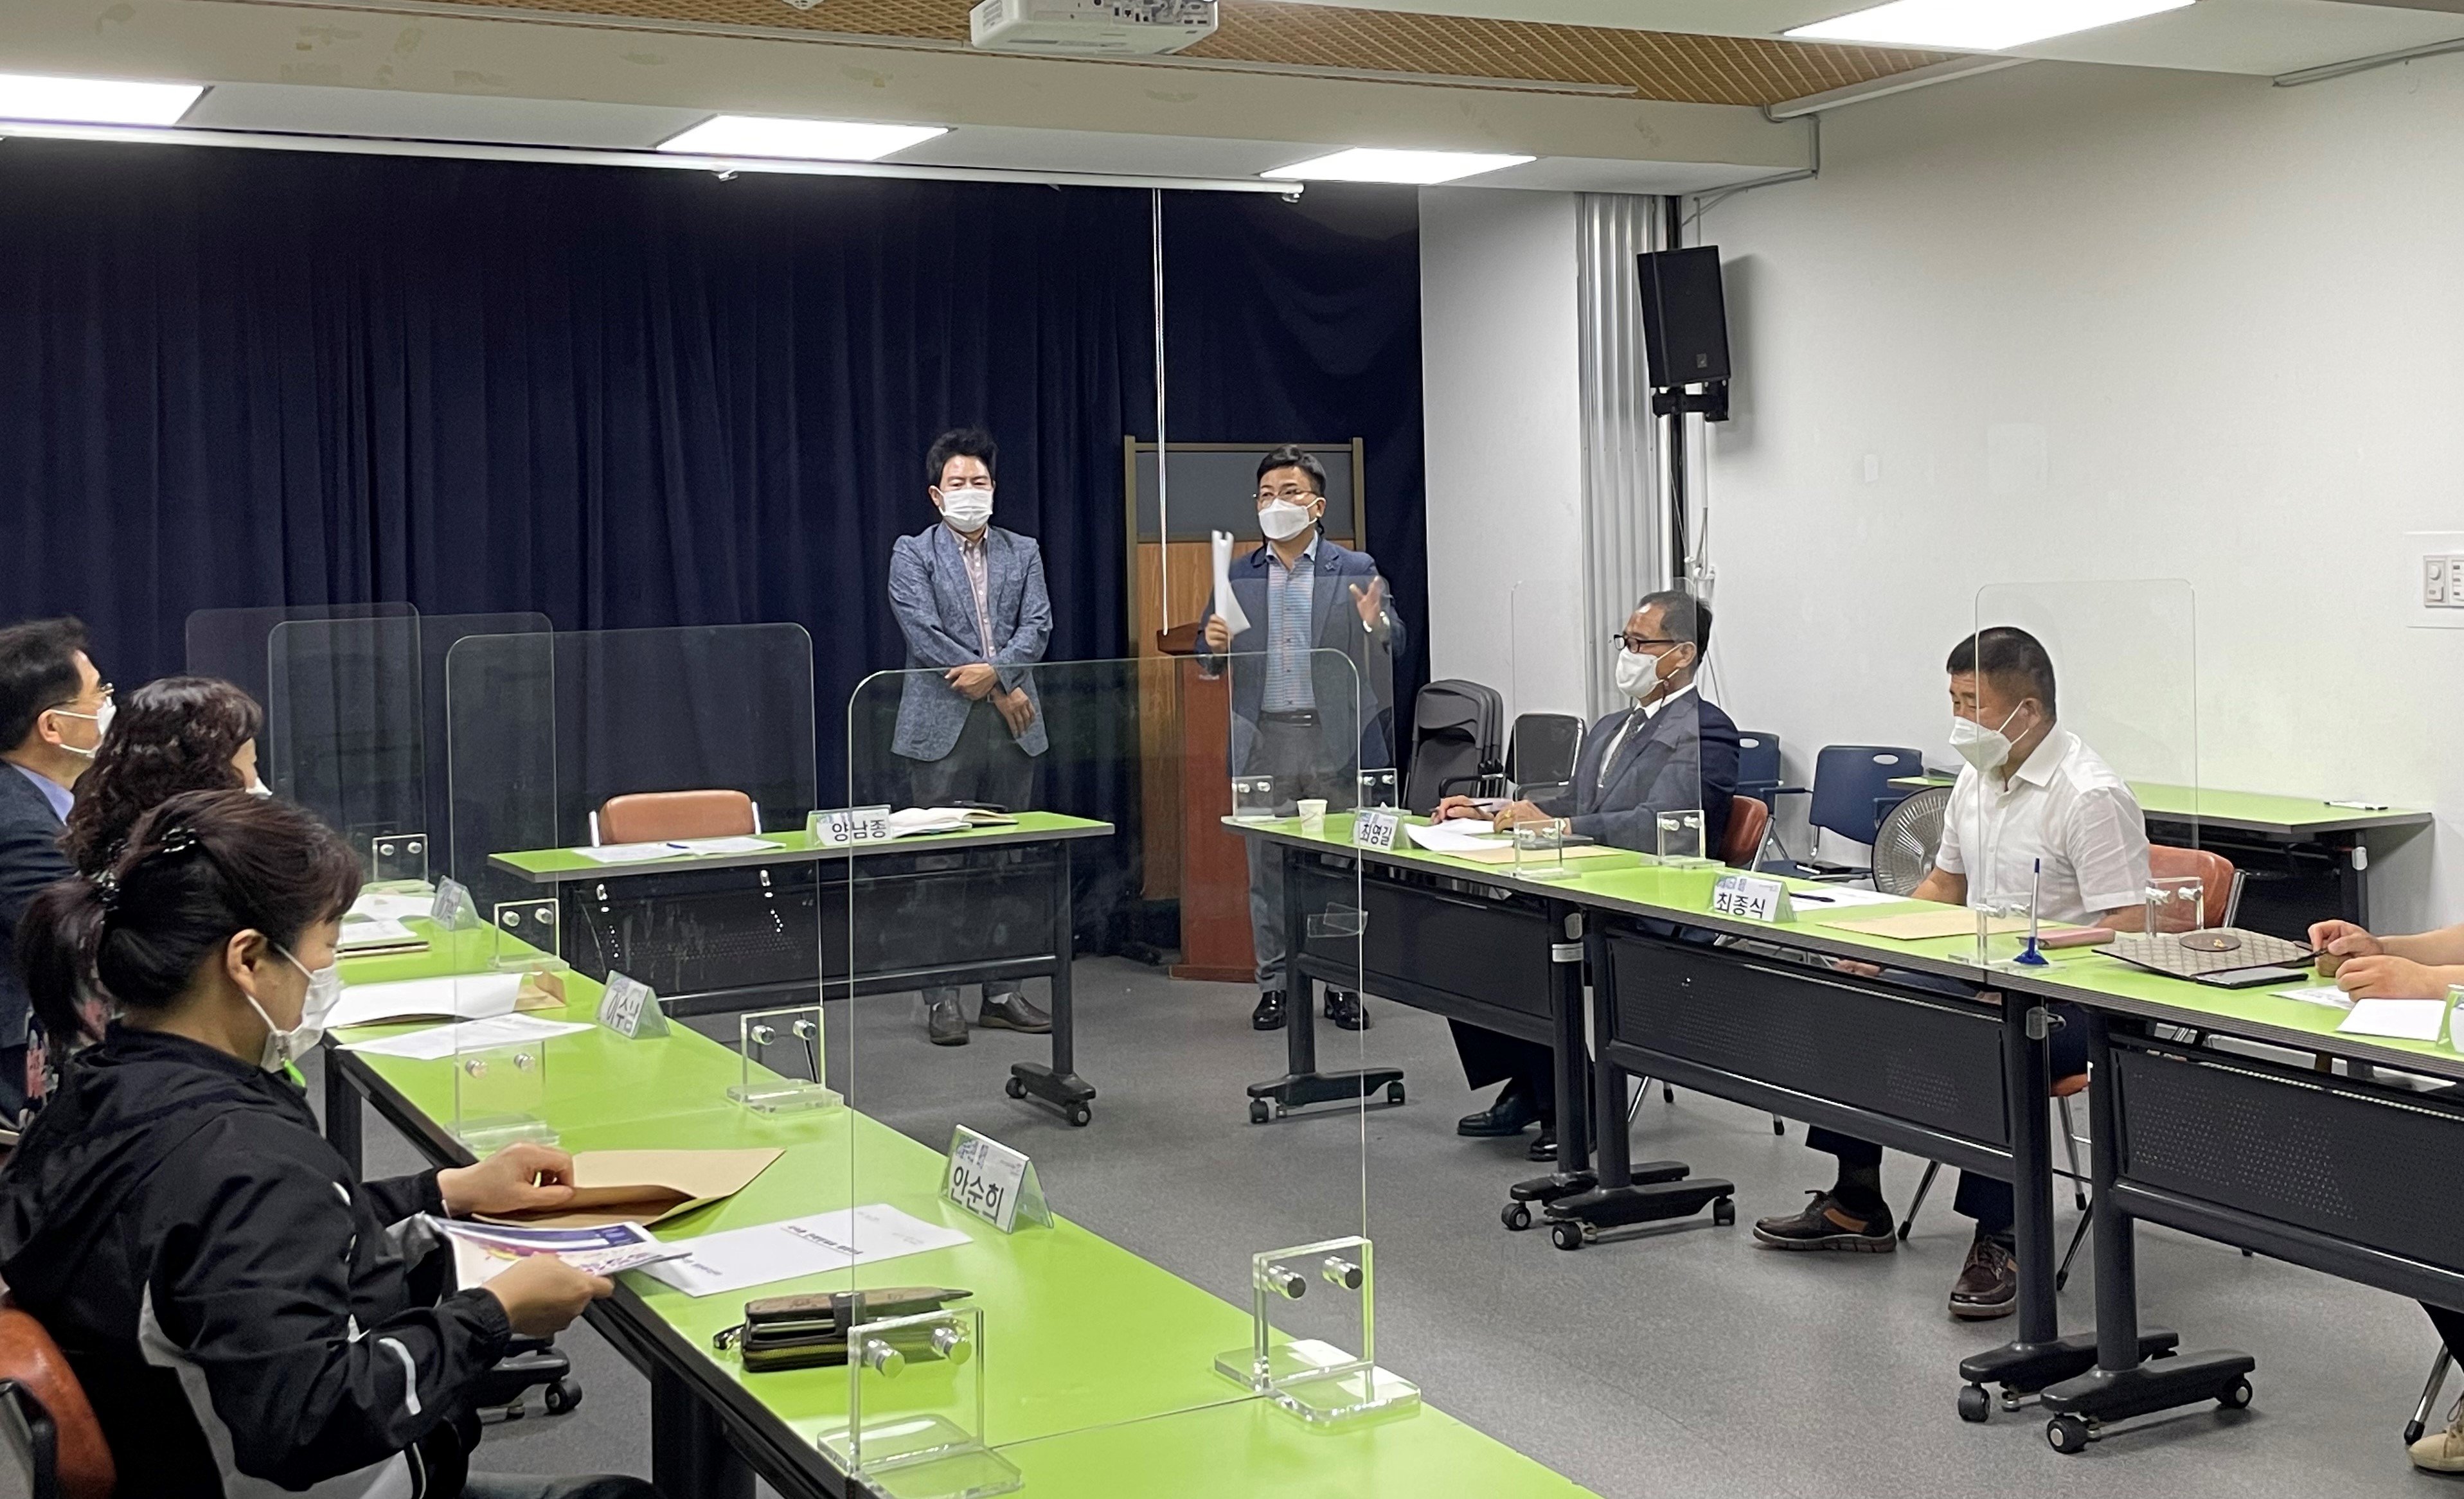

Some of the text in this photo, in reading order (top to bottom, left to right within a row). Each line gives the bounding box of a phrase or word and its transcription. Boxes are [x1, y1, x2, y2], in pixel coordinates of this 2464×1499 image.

[832, 819, 886, 841] 양남종
[1715, 892, 1765, 918] 최종식
[951, 1166, 1004, 1224] 안순희
